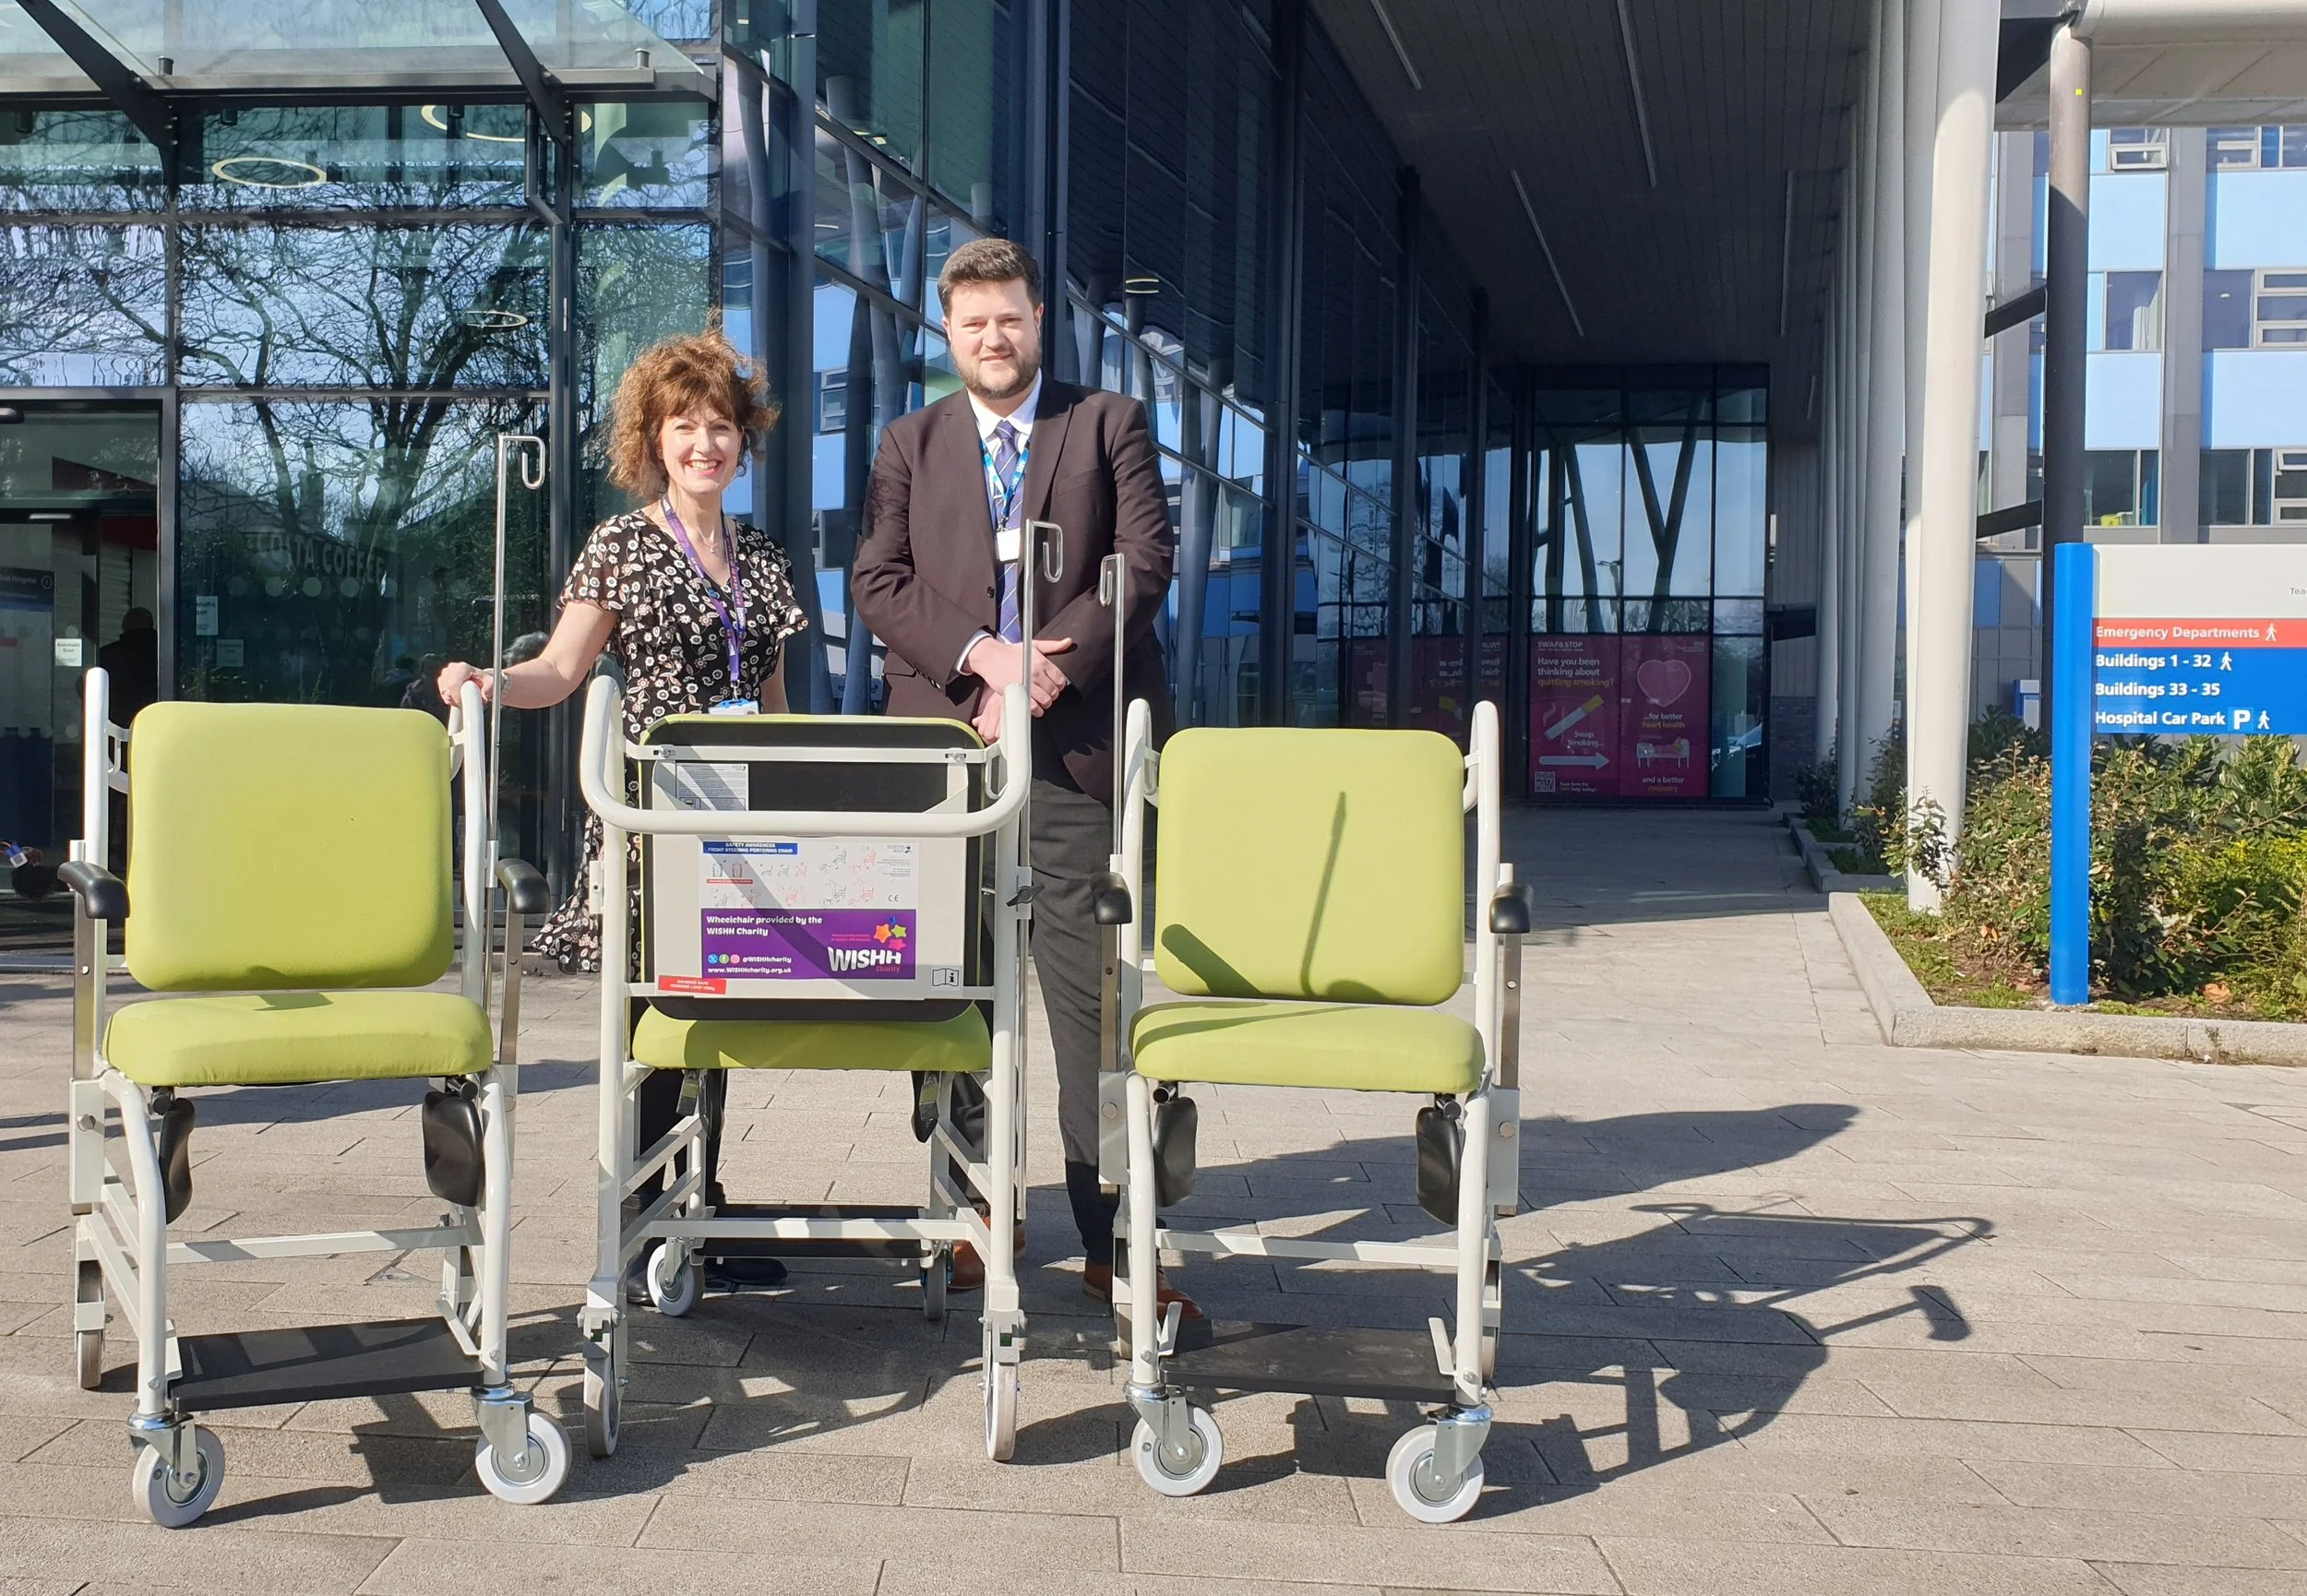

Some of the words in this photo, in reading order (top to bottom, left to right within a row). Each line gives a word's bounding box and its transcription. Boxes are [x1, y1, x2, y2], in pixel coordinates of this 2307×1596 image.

[322, 542, 386, 585] COFFEE
[2289, 587, 2307, 595] Tea
[2097, 625, 2169, 640] Emergency
[2172, 625, 2260, 640] Departments
[1537, 657, 1559, 665] Have
[1560, 658, 1577, 667] you
[1578, 657, 1600, 665] been
[2096, 653, 2166, 670] Buildings
[2170, 655, 2178, 667] 1
[2193, 655, 2212, 667] 32
[1537, 667, 1572, 677] thinking
[1574, 667, 1600, 676] about
[1537, 677, 1572, 687] quitting
[1572, 677, 1614, 688] smoking?
[2095, 682, 2165, 698] Buildings
[2169, 684, 2188, 696] 33
[2201, 684, 2220, 696] 35
[1660, 712, 1683, 721] better
[2095, 710, 2158, 728] Hospital
[2162, 711, 2188, 725] Car
[2192, 711, 2226, 725] Park
[2233, 709, 2251, 730] P
[1573, 731, 1595, 741] Swap
[706, 915, 754, 923] Wheelchair
[755, 916, 795, 925] provided
[795, 916, 807, 925] by
[807, 916, 823, 924] the
[706, 927, 735, 935] WISHH
[736, 927, 769, 936] Charity
[742, 956, 792, 964] @WISHHcharity
[827, 946, 902, 971] WISHH
[876, 965, 901, 974] Charity
